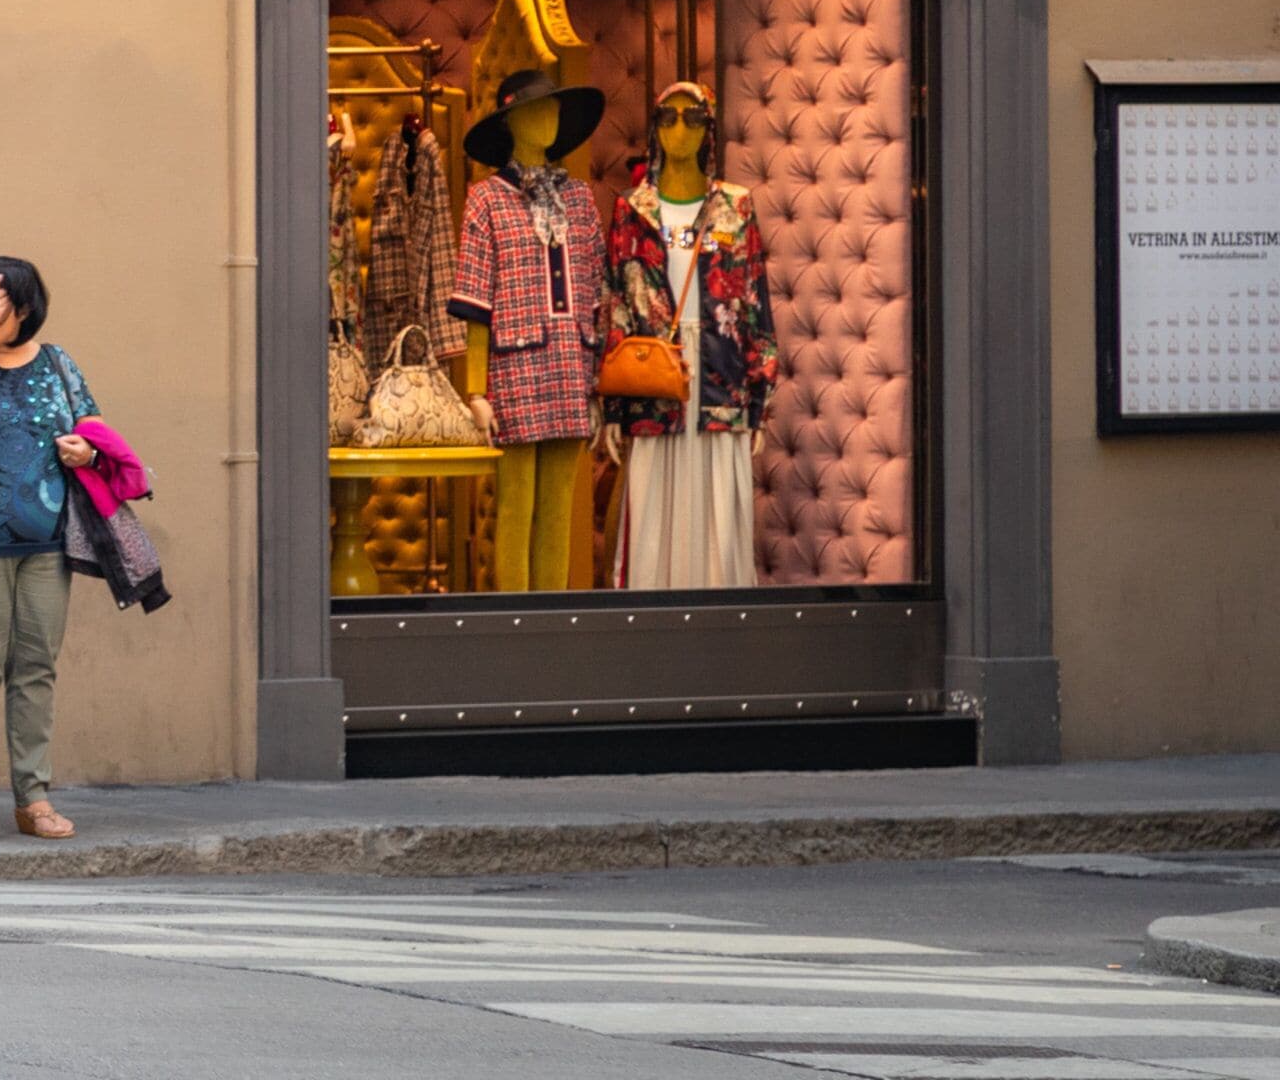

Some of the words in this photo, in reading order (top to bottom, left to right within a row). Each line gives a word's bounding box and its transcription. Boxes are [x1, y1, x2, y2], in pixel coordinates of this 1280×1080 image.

[1128, 231, 1189, 247] VETRINA
[1192, 231, 1207, 247] IN
[1210, 231, 1280, 247] ALLESTIM
